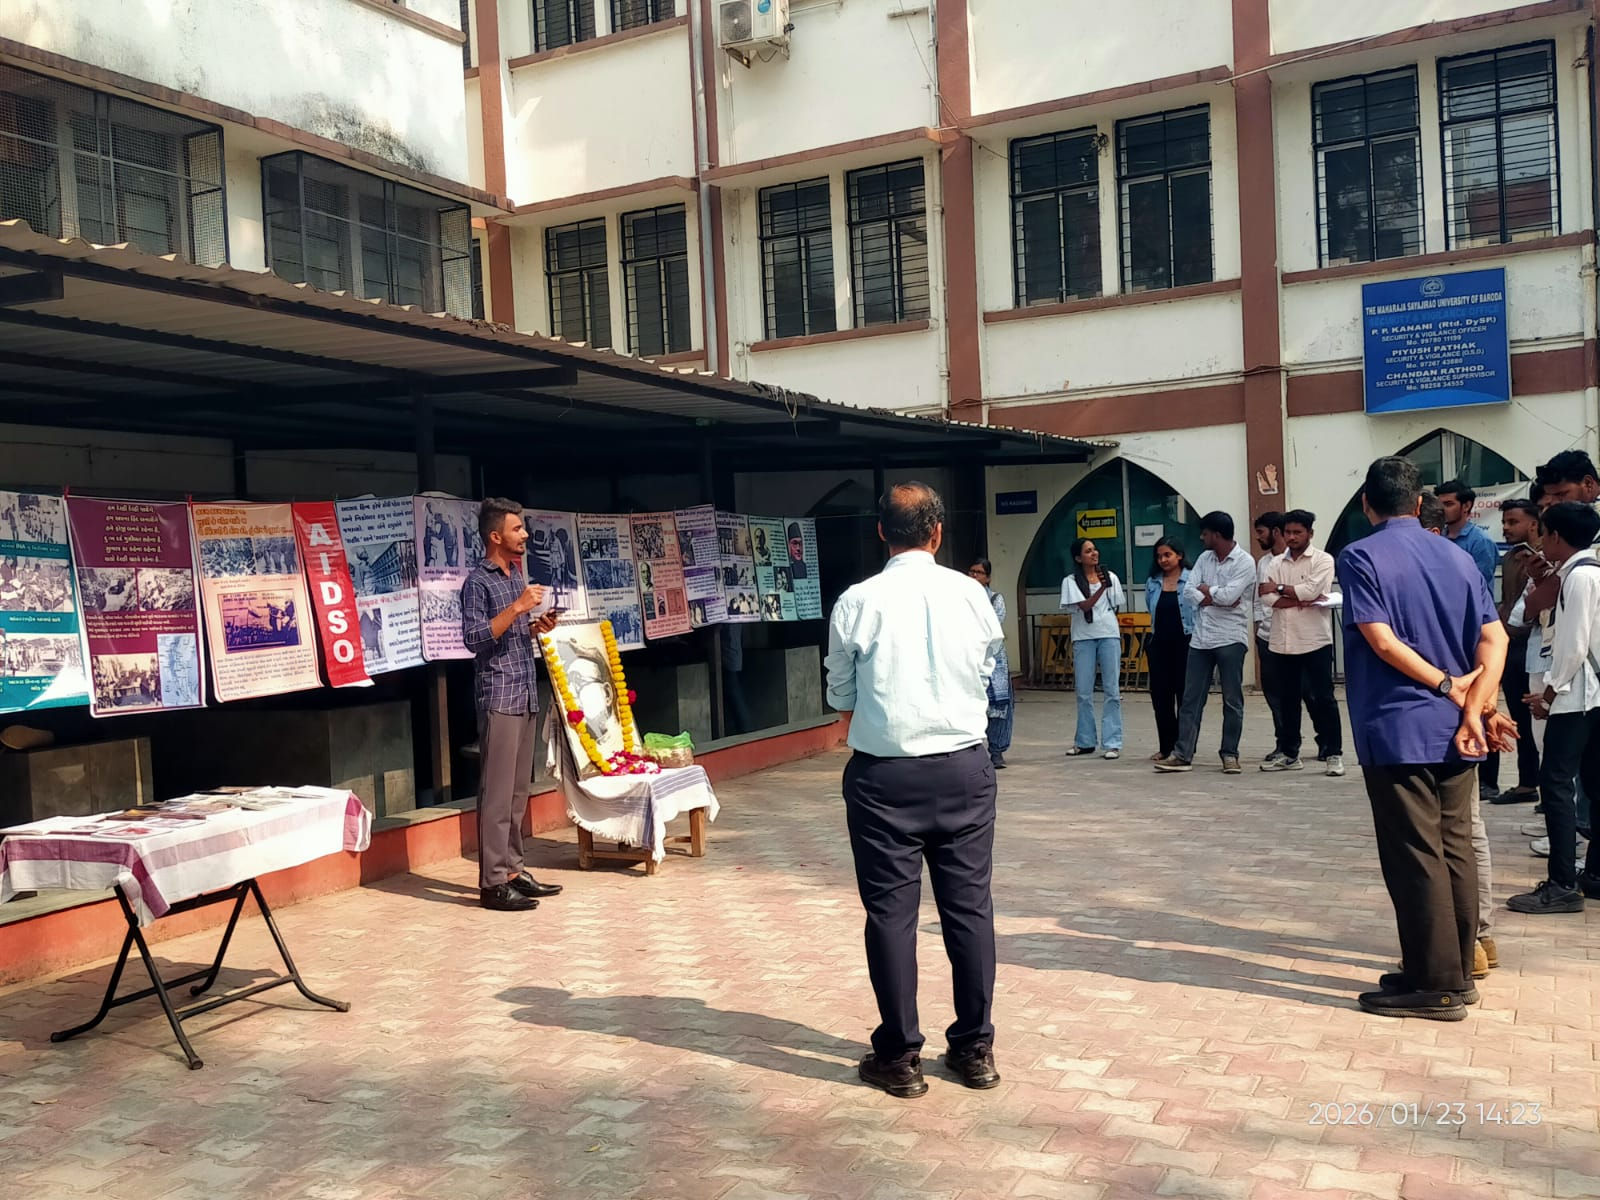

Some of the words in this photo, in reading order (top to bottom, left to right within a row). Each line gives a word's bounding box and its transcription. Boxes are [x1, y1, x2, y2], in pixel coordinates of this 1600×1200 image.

[1366, 306, 1376, 315] THE
[1377, 304, 1406, 314] MAHARAJA
[1407, 300, 1436, 310] SAYAJIRAO
[1437, 297, 1470, 307] UNIVERSITY
[1471, 296, 1478, 304] OF
[1479, 292, 1503, 302] BARODA
[1382, 334, 1414, 342] SECURITY
[1421, 329, 1457, 338] VIGILANCE
[1458, 326, 1487, 334] OFFICER
[1392, 323, 1432, 333] KANANI
[1392, 347, 1431, 356] PIYUSH
[1434, 342, 1476, 352] PATHAK
[1386, 355, 1418, 363] SECURITY
[1426, 351, 1460, 359] VIGILANCE
[1376, 379, 1408, 388] SECURITY
[1416, 375, 1451, 383] VIGILANCE
[1452, 371, 1495, 379] SUPERVISOR
[1386, 369, 1438, 380] CHANDAN
[1441, 365, 1485, 375] RATHOD
[309, 522, 355, 664] AIDSO
